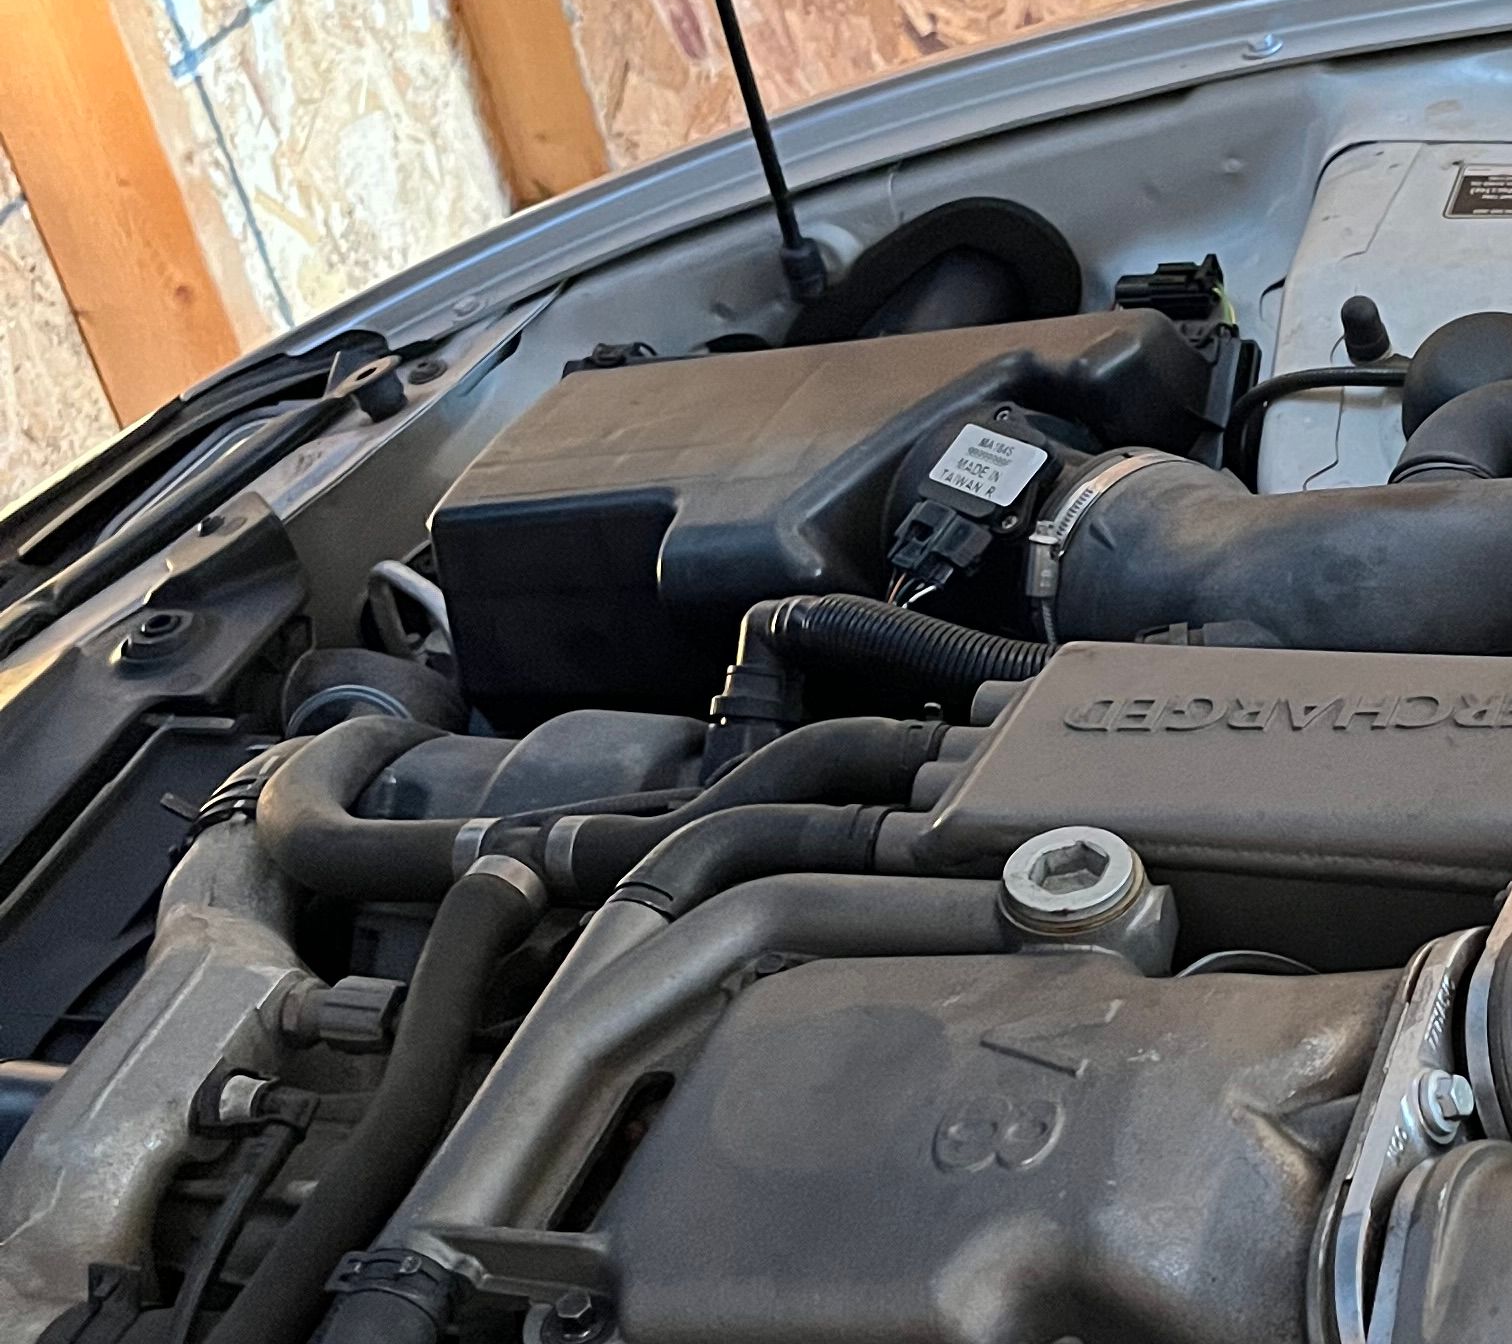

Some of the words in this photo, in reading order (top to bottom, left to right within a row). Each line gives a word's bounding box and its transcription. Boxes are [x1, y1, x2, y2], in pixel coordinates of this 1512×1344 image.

[940, 468, 982, 495] TAIWAN
[985, 485, 996, 500] R
[957, 458, 989, 480] MADE
[990, 468, 1001, 483] IN
